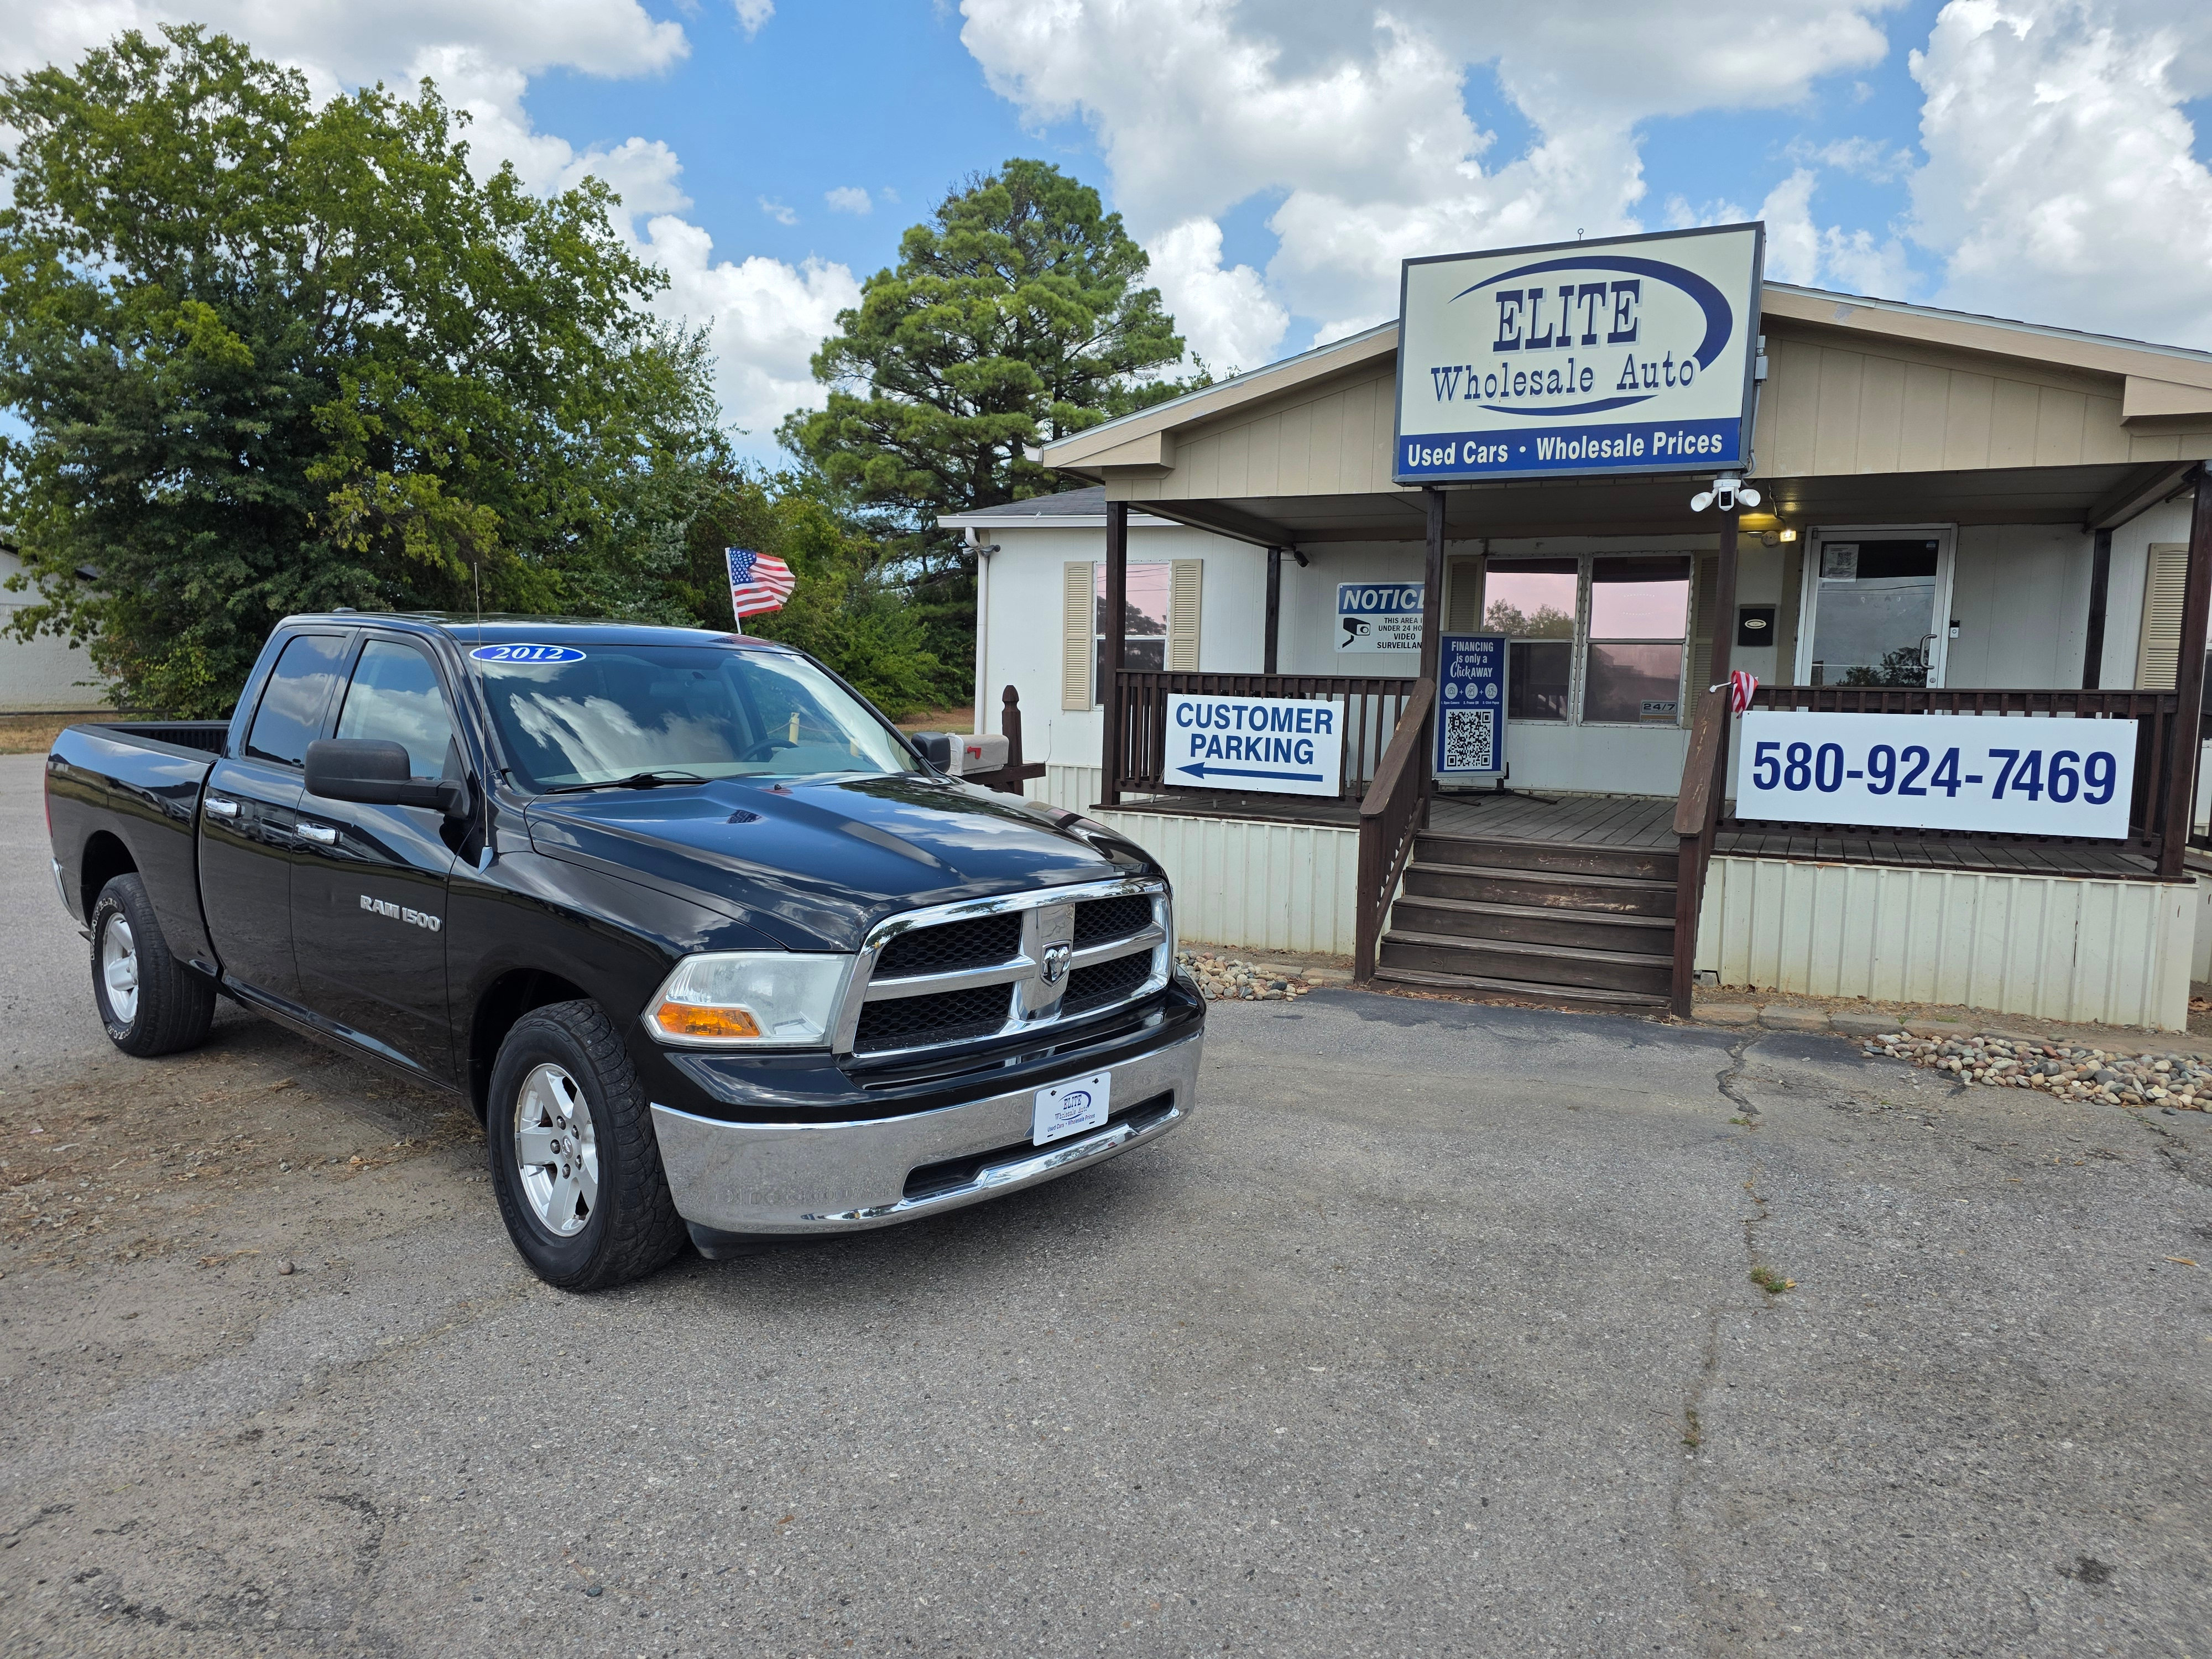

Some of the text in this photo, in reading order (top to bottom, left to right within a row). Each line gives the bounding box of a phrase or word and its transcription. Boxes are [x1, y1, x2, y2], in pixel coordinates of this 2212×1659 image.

[1493, 279, 1641, 352] ELITE
[1431, 350, 1696, 403] Wholesale Auto
[1407, 431, 1723, 467] Used Cars Wholesale Prices
[491, 647, 564, 660] 2012
[1451, 641, 1494, 652] FINANCING
[1456, 653, 1488, 665] is only a
[1176, 702, 1333, 734] CUSTOMER
[1190, 733, 1314, 764] PARKING
[1752, 741, 2117, 805] 580-924-7469
[360, 894, 441, 932] RAM 1500
[1055, 1108, 1076, 1120] Wholesale
[1063, 1094, 1082, 1110] ELITE
[1068, 1117, 1084, 1125] Wholesale
